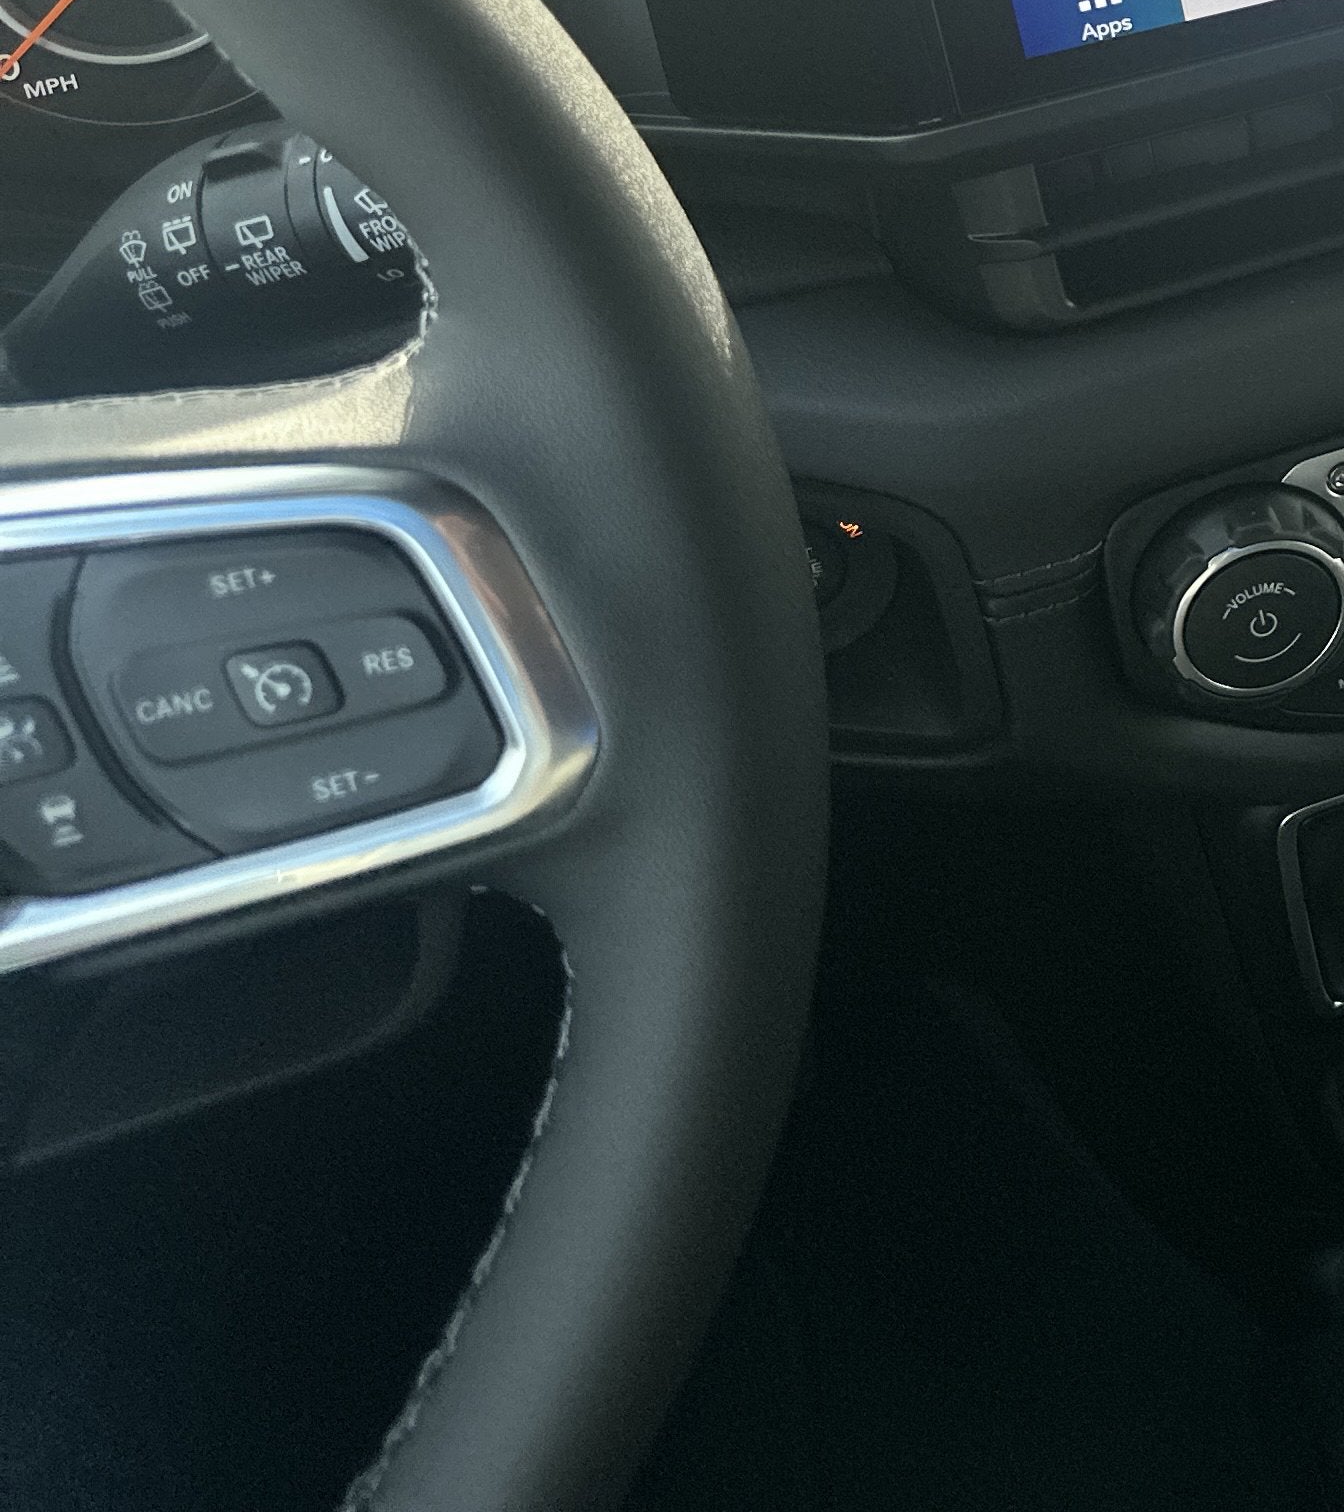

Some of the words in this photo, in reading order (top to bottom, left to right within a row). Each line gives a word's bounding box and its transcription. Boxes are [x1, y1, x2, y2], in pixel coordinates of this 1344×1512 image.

[1081, 14, 1134, 43] Apps
[23, 73, 79, 99] MPH
[166, 181, 193, 204] ON
[358, 215, 402, 241] FRO
[240, 245, 290, 271] REAR
[126, 266, 158, 284] PULL
[176, 264, 211, 288] OFF
[245, 260, 308, 287] WIPER
[156, 311, 193, 329] PUSH
[1226, 580, 1285, 612] VOLUME
[360, 647, 416, 676] RES
[135, 688, 214, 725] CANC
